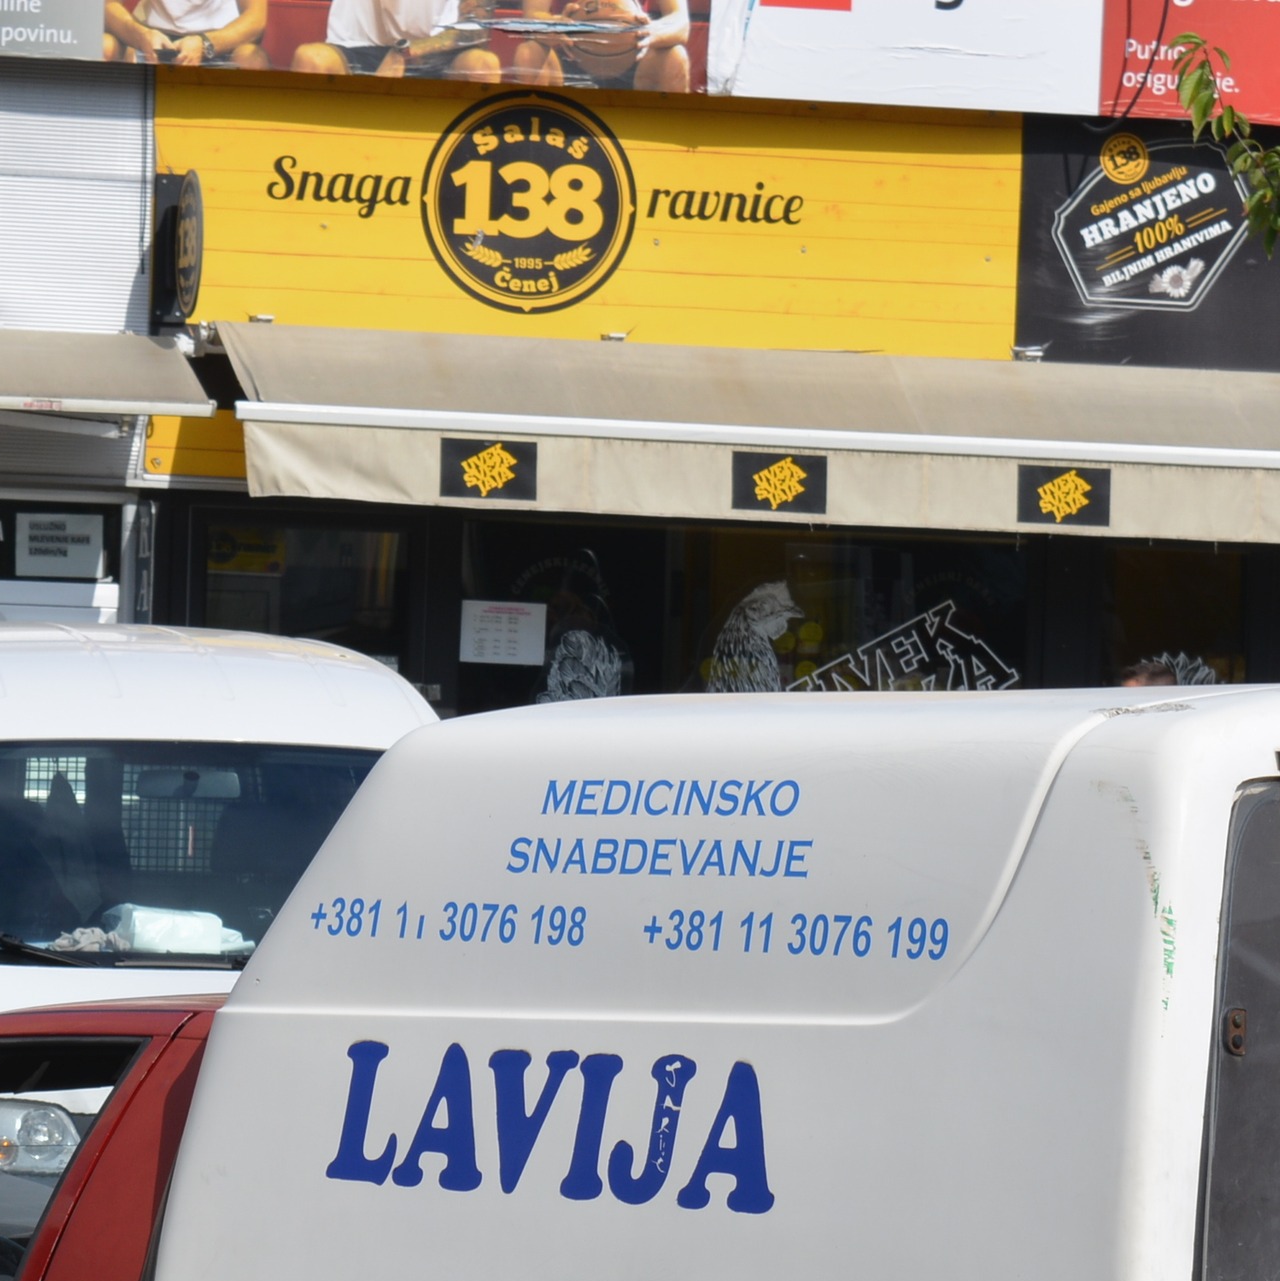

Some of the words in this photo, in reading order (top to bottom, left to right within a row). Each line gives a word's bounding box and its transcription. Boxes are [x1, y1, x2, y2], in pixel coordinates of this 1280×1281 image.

[472, 116, 589, 160] Salaš
[1107, 145, 1141, 170] 138
[265, 154, 411, 219] Snaga
[451, 160, 604, 241] 138
[646, 181, 804, 226] ravnice
[1079, 172, 1216, 248] HRANJENO
[1090, 194, 1129, 216] Gajeno
[1129, 188, 1142, 200] sa
[1141, 165, 1188, 195] ljubavlju
[1102, 257, 1156, 288] BILJNIM
[1154, 219, 1233, 263] HRANIVIMA
[1133, 213, 1186, 254] 100%
[494, 266, 559, 293] Čenej
[513, 257, 543, 269] 1995
[540, 780, 801, 817] MEDICINSKO
[505, 837, 813, 878] SNABDEVANJE
[310, 897, 381, 938] +381
[439, 901, 517, 944] 3076
[530, 904, 587, 947] 198
[643, 909, 723, 952] +381
[739, 911, 774, 955] 11
[787, 913, 872, 958] 3076
[886, 916, 950, 961] 199
[325, 1039, 775, 1214] LAVIJA
